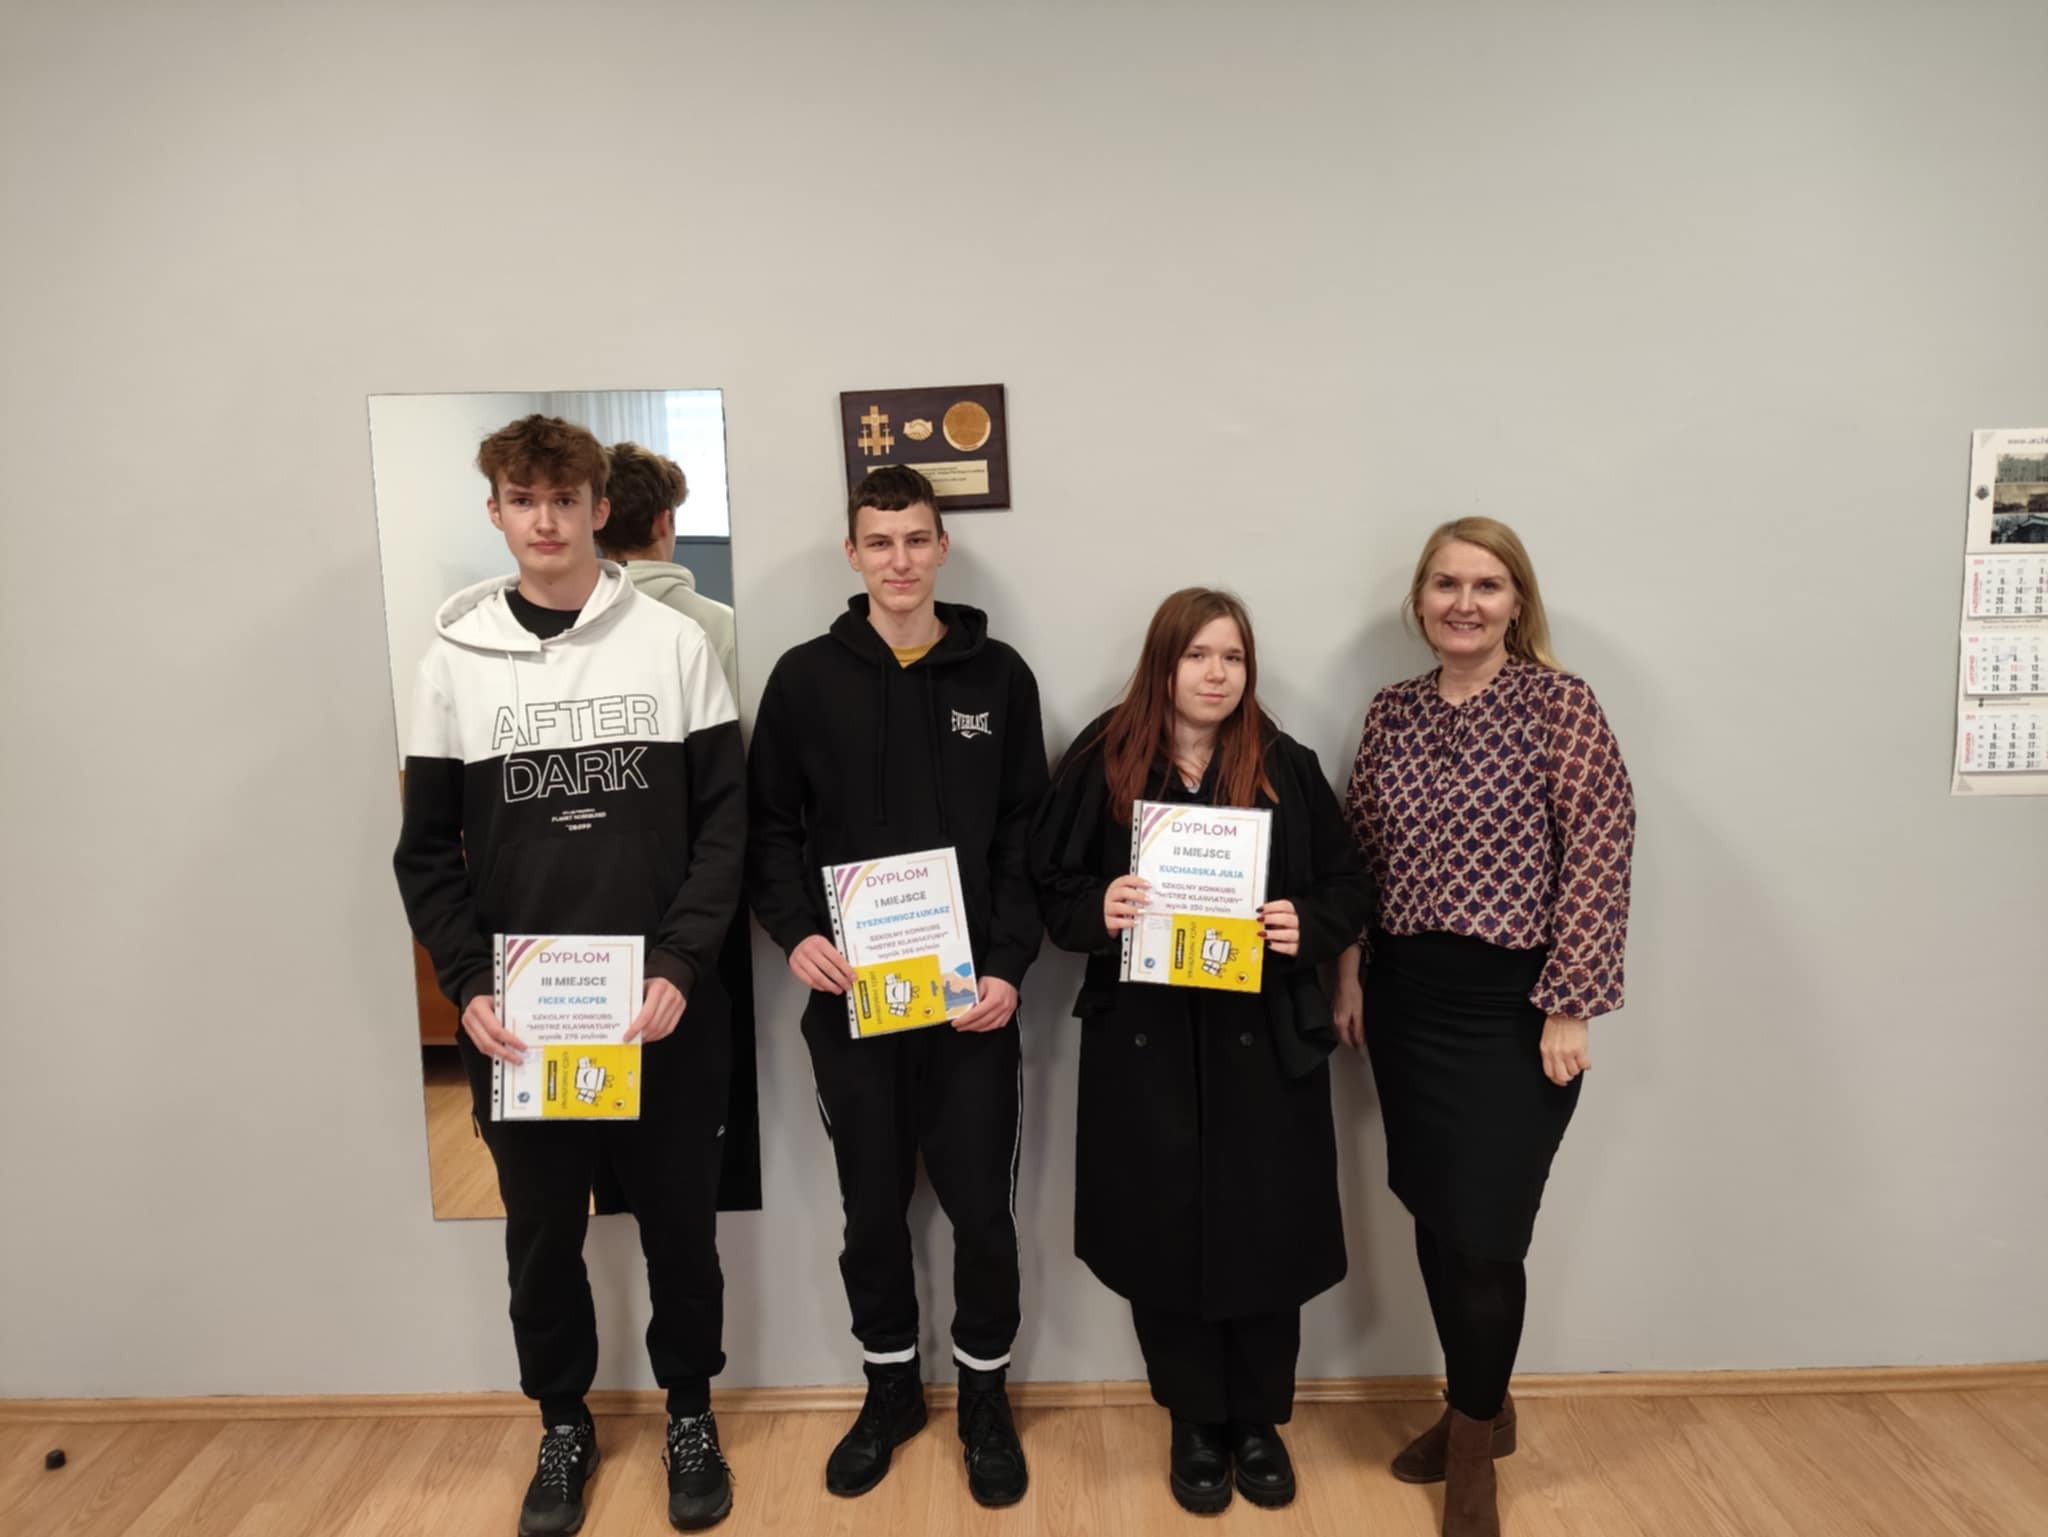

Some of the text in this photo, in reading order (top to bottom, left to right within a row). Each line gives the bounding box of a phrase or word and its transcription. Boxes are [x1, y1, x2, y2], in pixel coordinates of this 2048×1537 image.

[492, 694, 659, 750] AFTER
[504, 747, 648, 803] DARK
[1171, 822, 1237, 836] DYPLOM
[1173, 846, 1232, 860] II MIEJSCE
[866, 867, 929, 888] DYPLOM
[1218, 869, 1244, 879] JULIA
[880, 891, 927, 907] MIEJSCE
[539, 952, 610, 964] DYPLOM
[541, 976, 608, 987] III MIEJSCE
[538, 996, 608, 1005] FICEK KACPER
